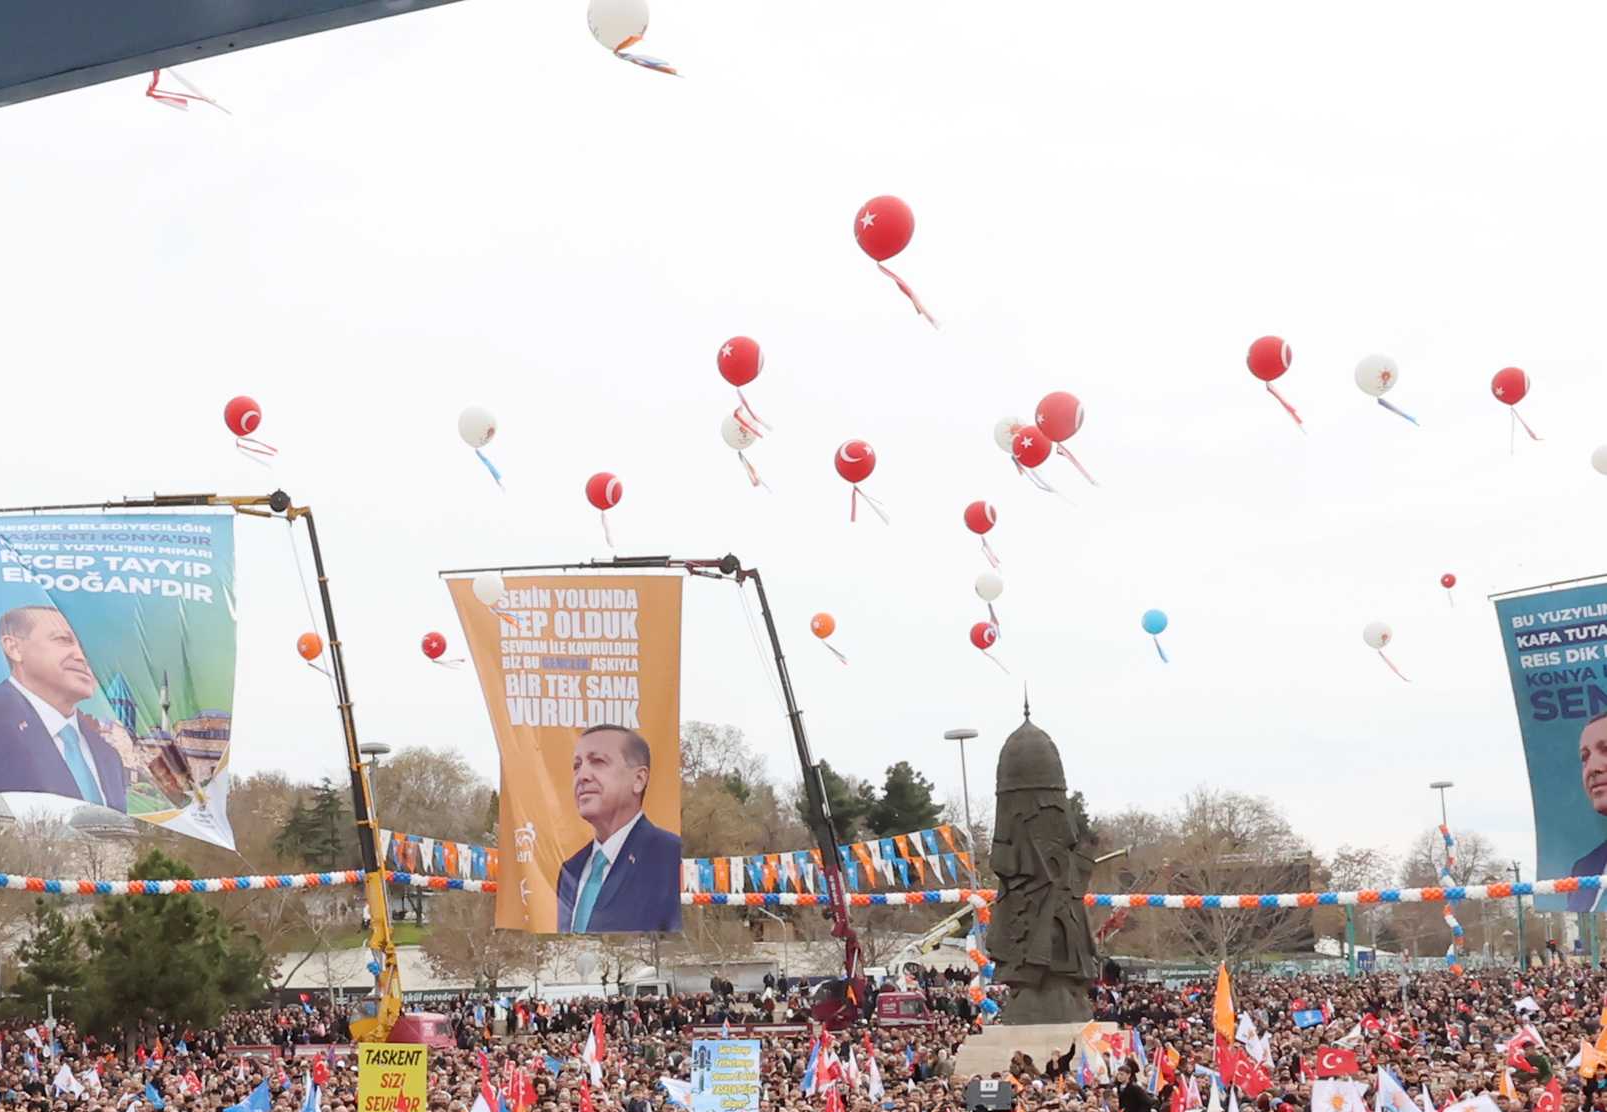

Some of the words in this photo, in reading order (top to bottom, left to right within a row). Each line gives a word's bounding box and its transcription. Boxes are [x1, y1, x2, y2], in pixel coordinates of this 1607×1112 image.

[0, 549, 95, 570] RECEP
[554, 589, 638, 609] YOLUNDA
[553, 610, 638, 639] OLDUK
[1511, 614, 1534, 629] BU
[1516, 631, 1562, 649] KAFA
[523, 656, 540, 669] BU
[545, 674, 582, 698] TEK
[586, 675, 638, 699] SANA
[1525, 667, 1597, 689] KONYA
[506, 698, 640, 729] VURULDUK
